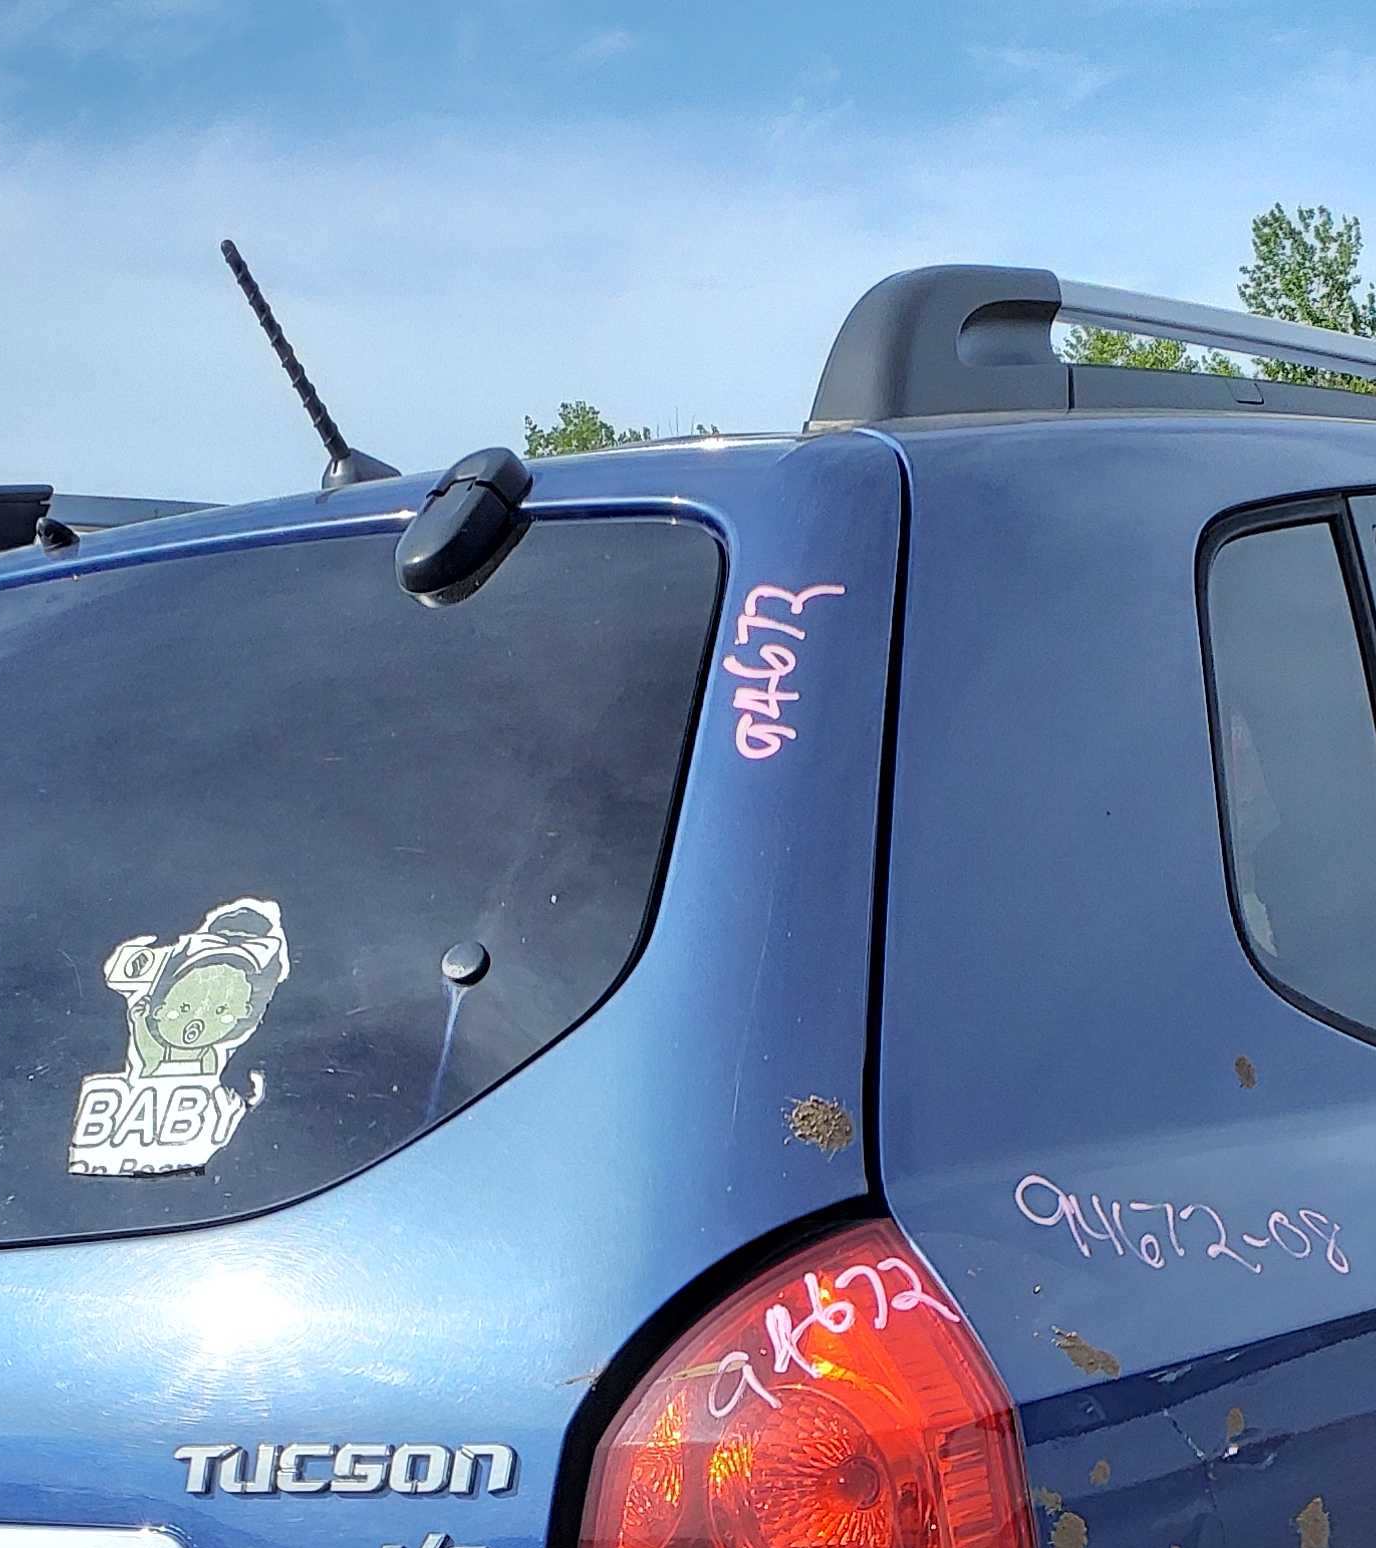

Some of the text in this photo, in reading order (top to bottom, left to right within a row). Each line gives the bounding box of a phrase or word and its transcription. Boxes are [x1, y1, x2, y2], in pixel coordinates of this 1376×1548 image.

[72, 1085, 242, 1148] BABY
[707, 1257, 961, 1418] 94672
[173, 1442, 519, 1496] TUCSON
